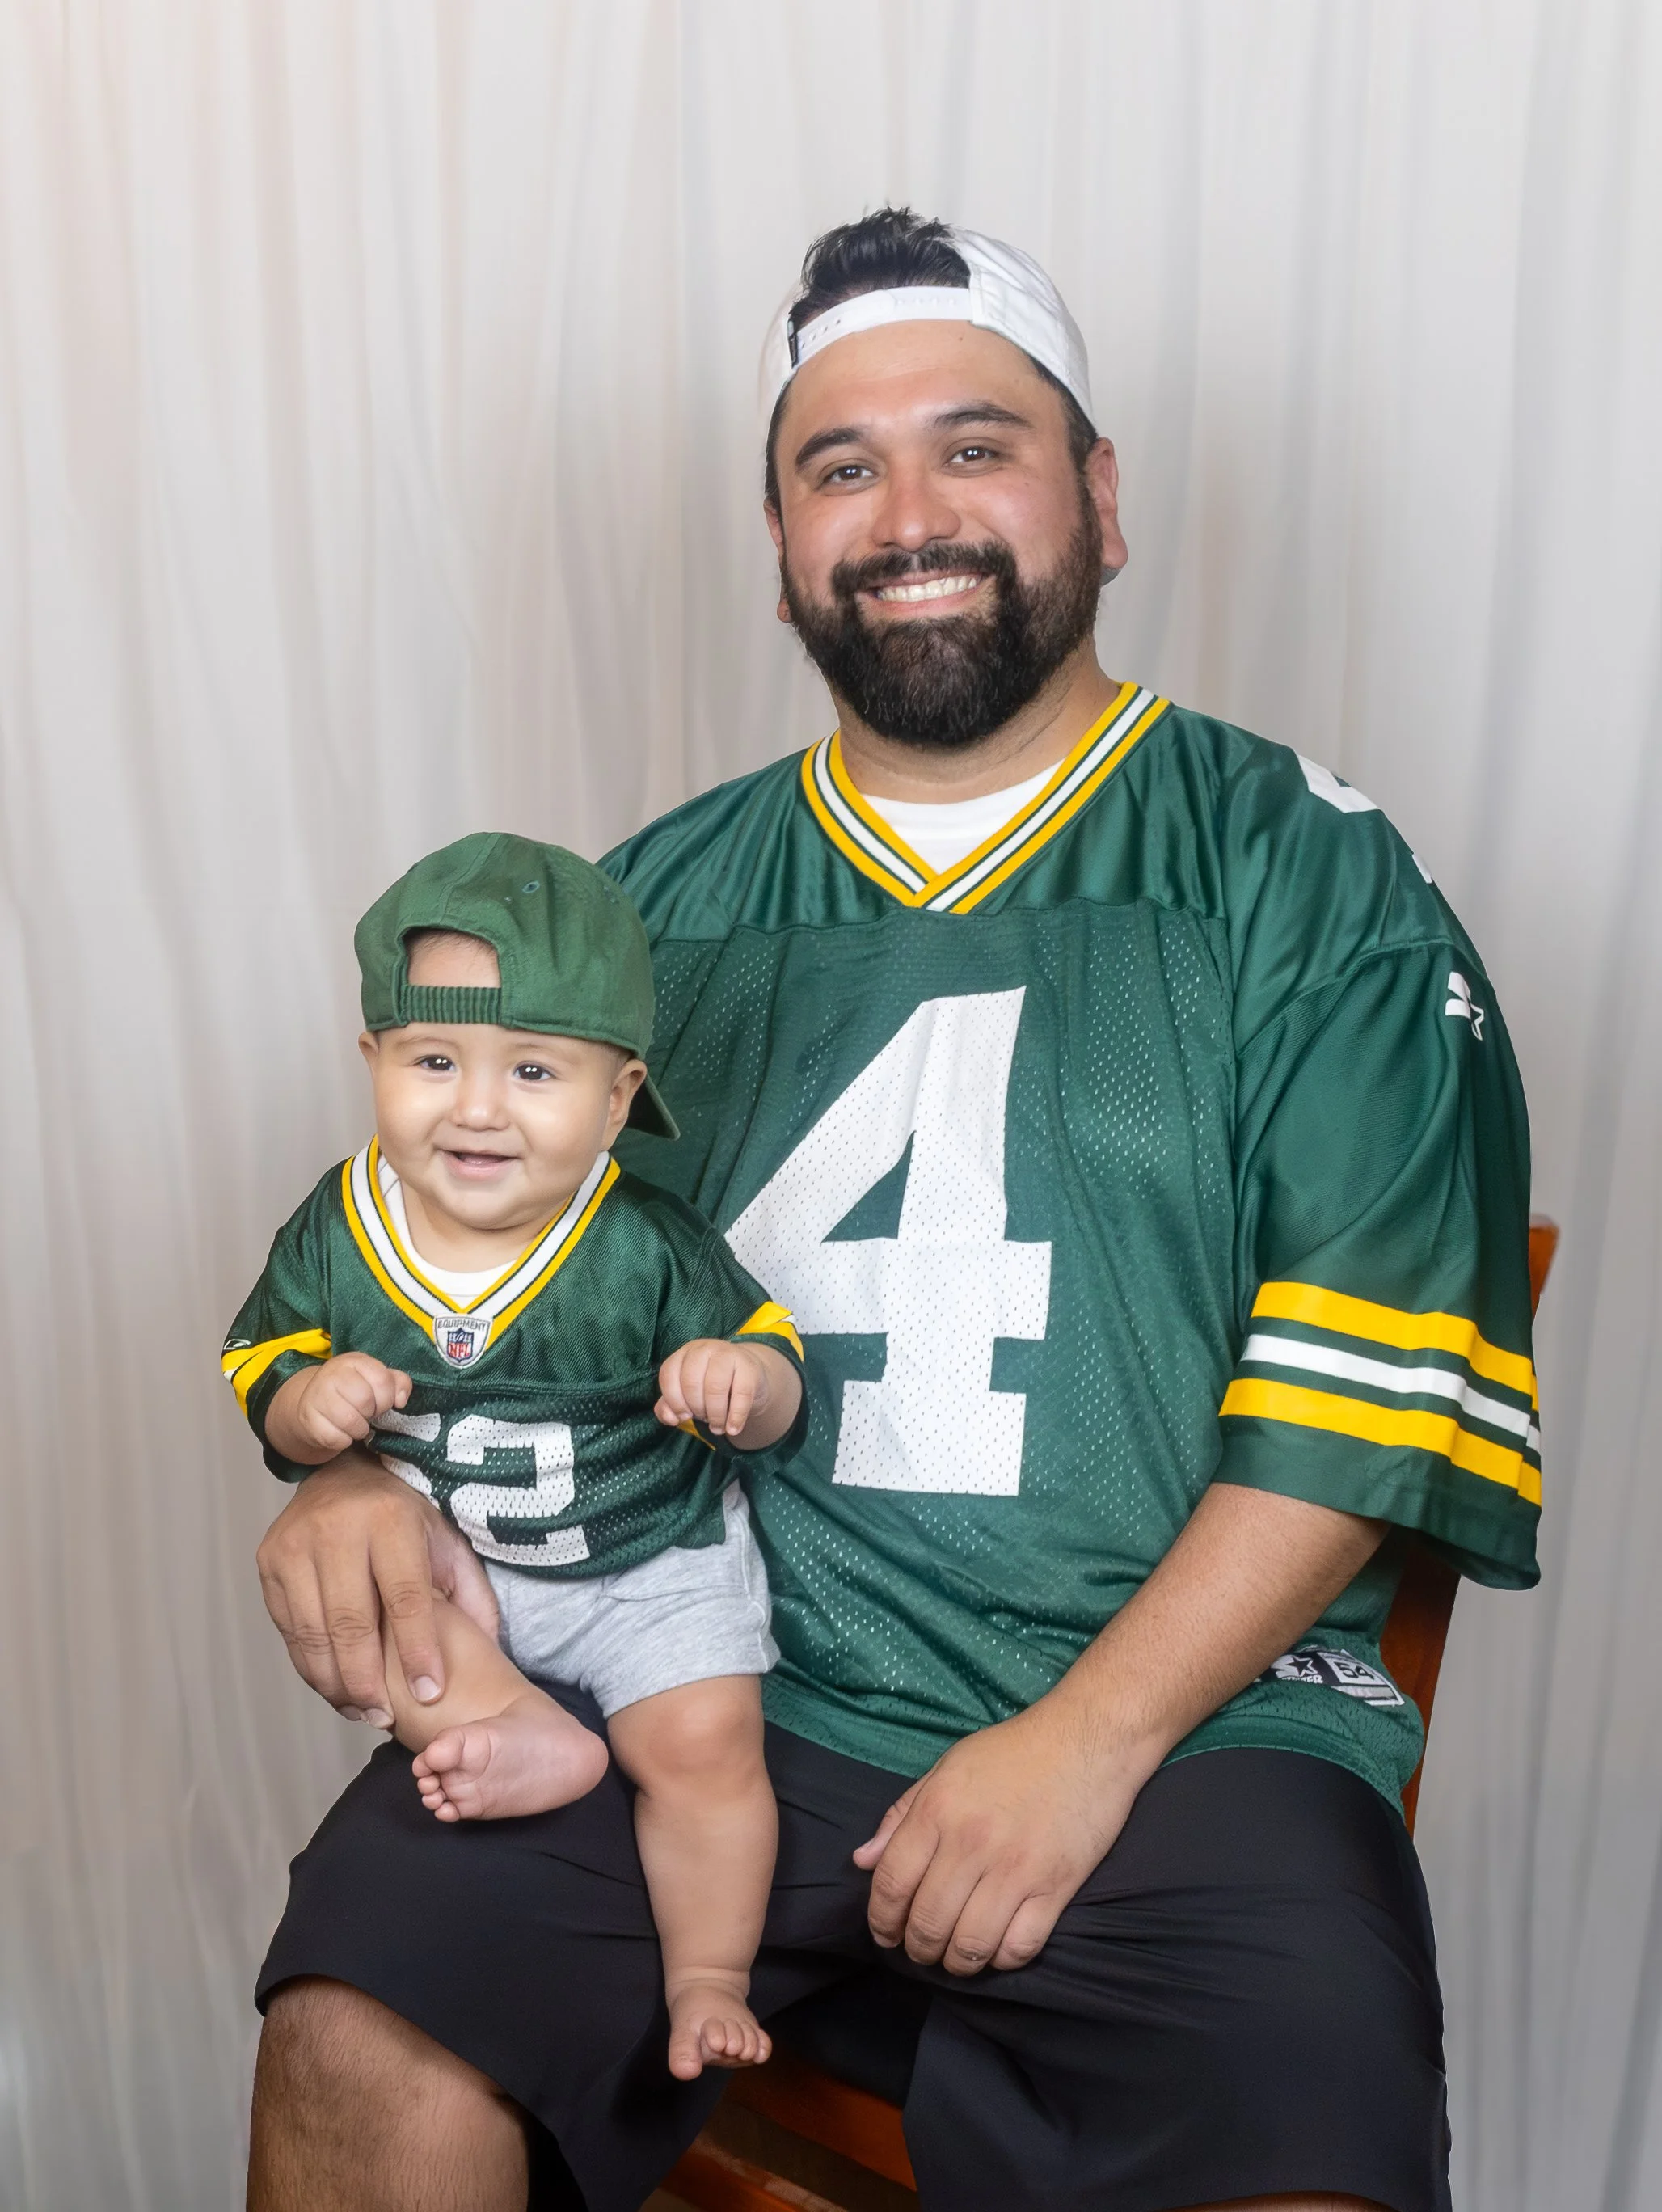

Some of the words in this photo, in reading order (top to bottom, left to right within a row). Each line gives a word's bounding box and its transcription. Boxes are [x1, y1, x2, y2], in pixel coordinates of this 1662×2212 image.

[724, 986, 1052, 1496] 4
[437, 1319, 487, 1332] EQUIPMENT
[449, 1343, 470, 1358] NFL
[1334, 1661, 1374, 1680] 54
